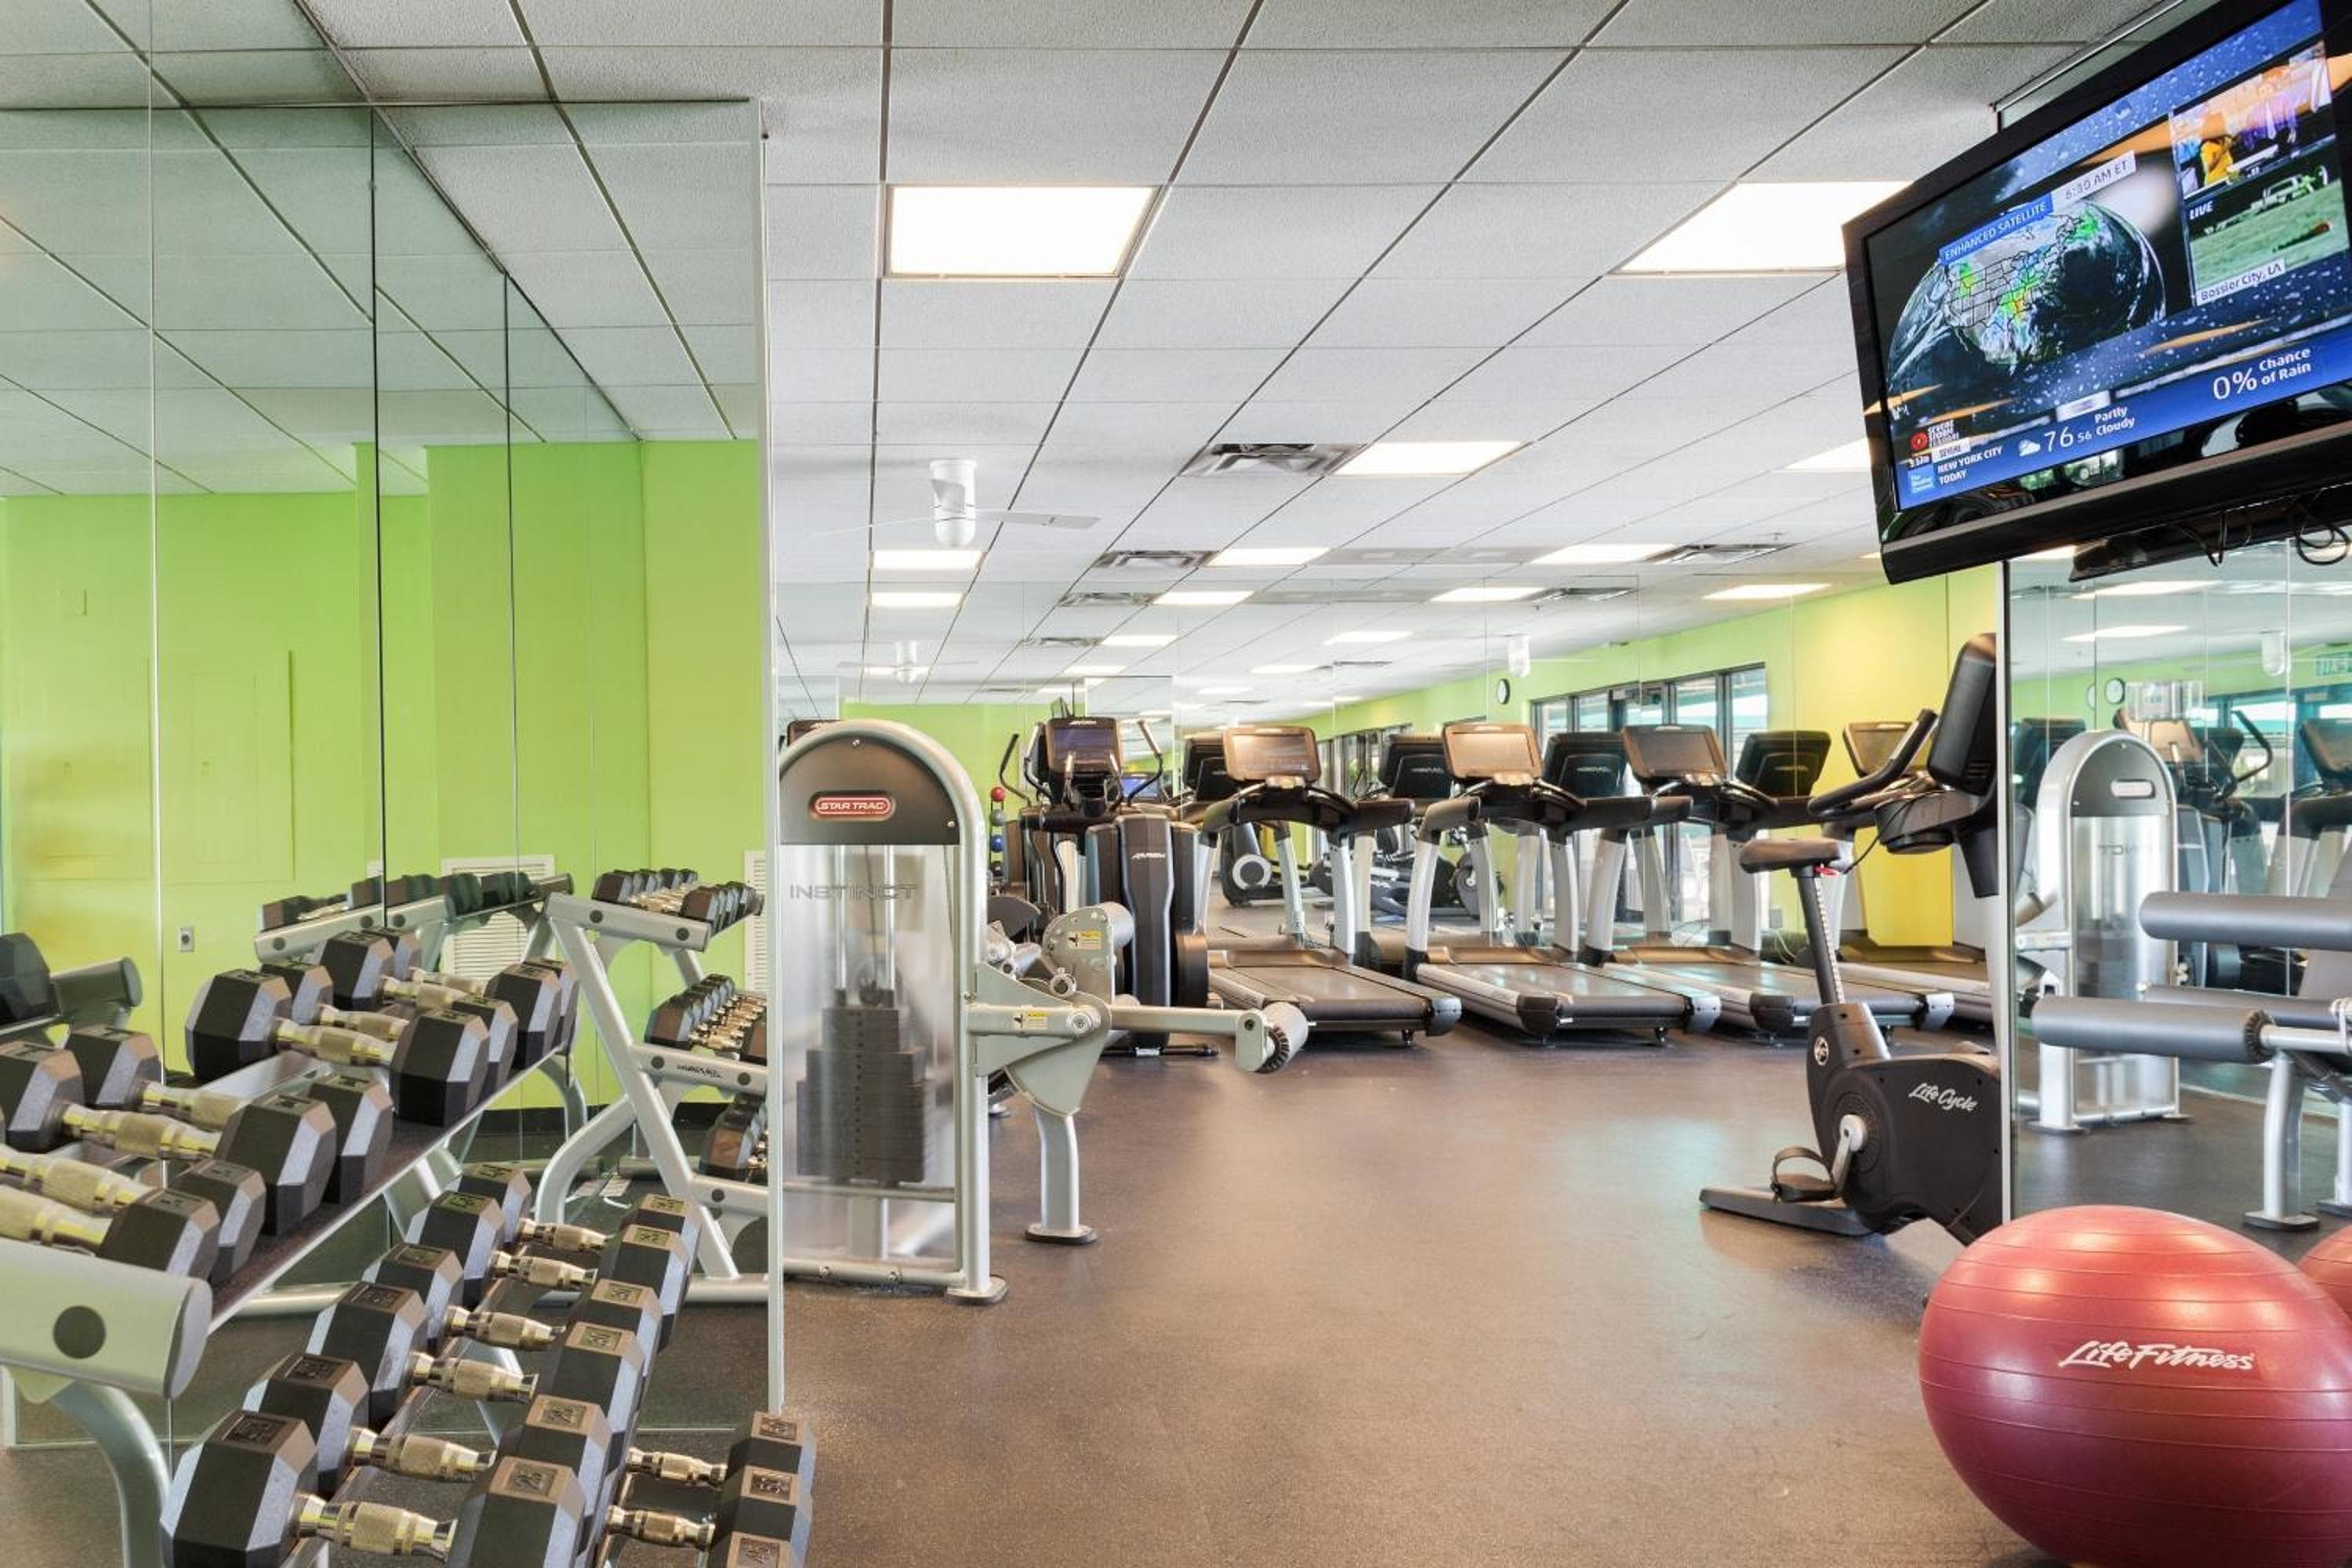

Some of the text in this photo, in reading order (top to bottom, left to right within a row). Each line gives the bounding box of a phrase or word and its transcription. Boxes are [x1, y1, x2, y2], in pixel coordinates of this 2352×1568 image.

[2092, 169, 2112, 185] AM
[2114, 160, 2129, 175] ET
[2189, 201, 2214, 220] LIVE
[1944, 201, 2047, 260] ENHANCED SATELLITE
[2267, 263, 2282, 275] LA
[2259, 348, 2311, 372] Chance
[2212, 367, 2258, 401] 0%
[2261, 363, 2312, 385] of Rain
[2094, 406, 2128, 423] Partly
[2077, 430, 2092, 443] 56
[2096, 417, 2136, 436] Cloudy
[2044, 426, 2074, 452] 76
[1937, 459, 1958, 473] NEW
[1958, 452, 1984, 466] YORK
[1984, 445, 2003, 459] CITY
[1939, 470, 1968, 485] TODAY
[818, 801, 885, 810] STAR TRAC
[789, 881, 918, 902] INSTINCT
